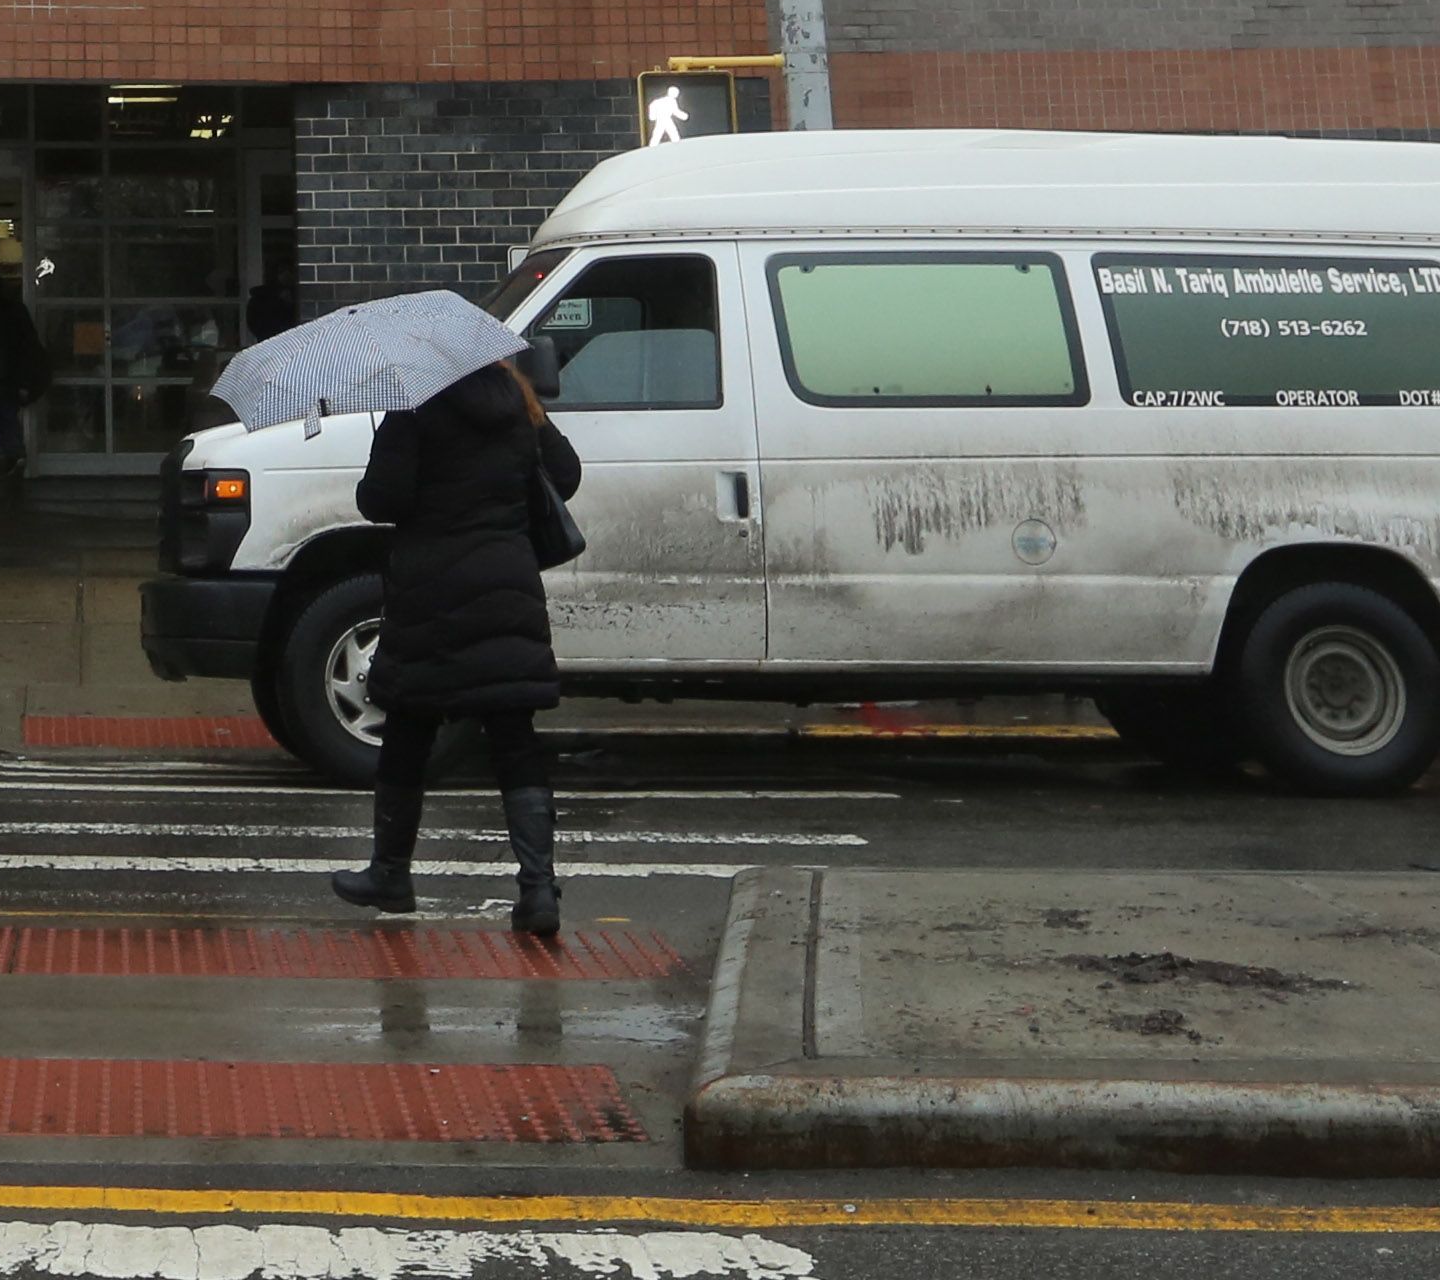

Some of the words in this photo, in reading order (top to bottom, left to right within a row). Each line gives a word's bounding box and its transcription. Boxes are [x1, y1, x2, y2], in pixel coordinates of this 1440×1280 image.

[1097, 267, 1148, 294] Basil
[1150, 267, 1174, 294] N.
[1174, 267, 1230, 298] Tariq
[1232, 267, 1323, 294] Ambulette
[1326, 267, 1409, 297] Service,
[1220, 318, 1271, 338] (718)
[1277, 319, 1368, 337] 513-6262
[1132, 390, 1226, 408] CAP.7/2WC
[1276, 390, 1360, 407] OPERATOR
